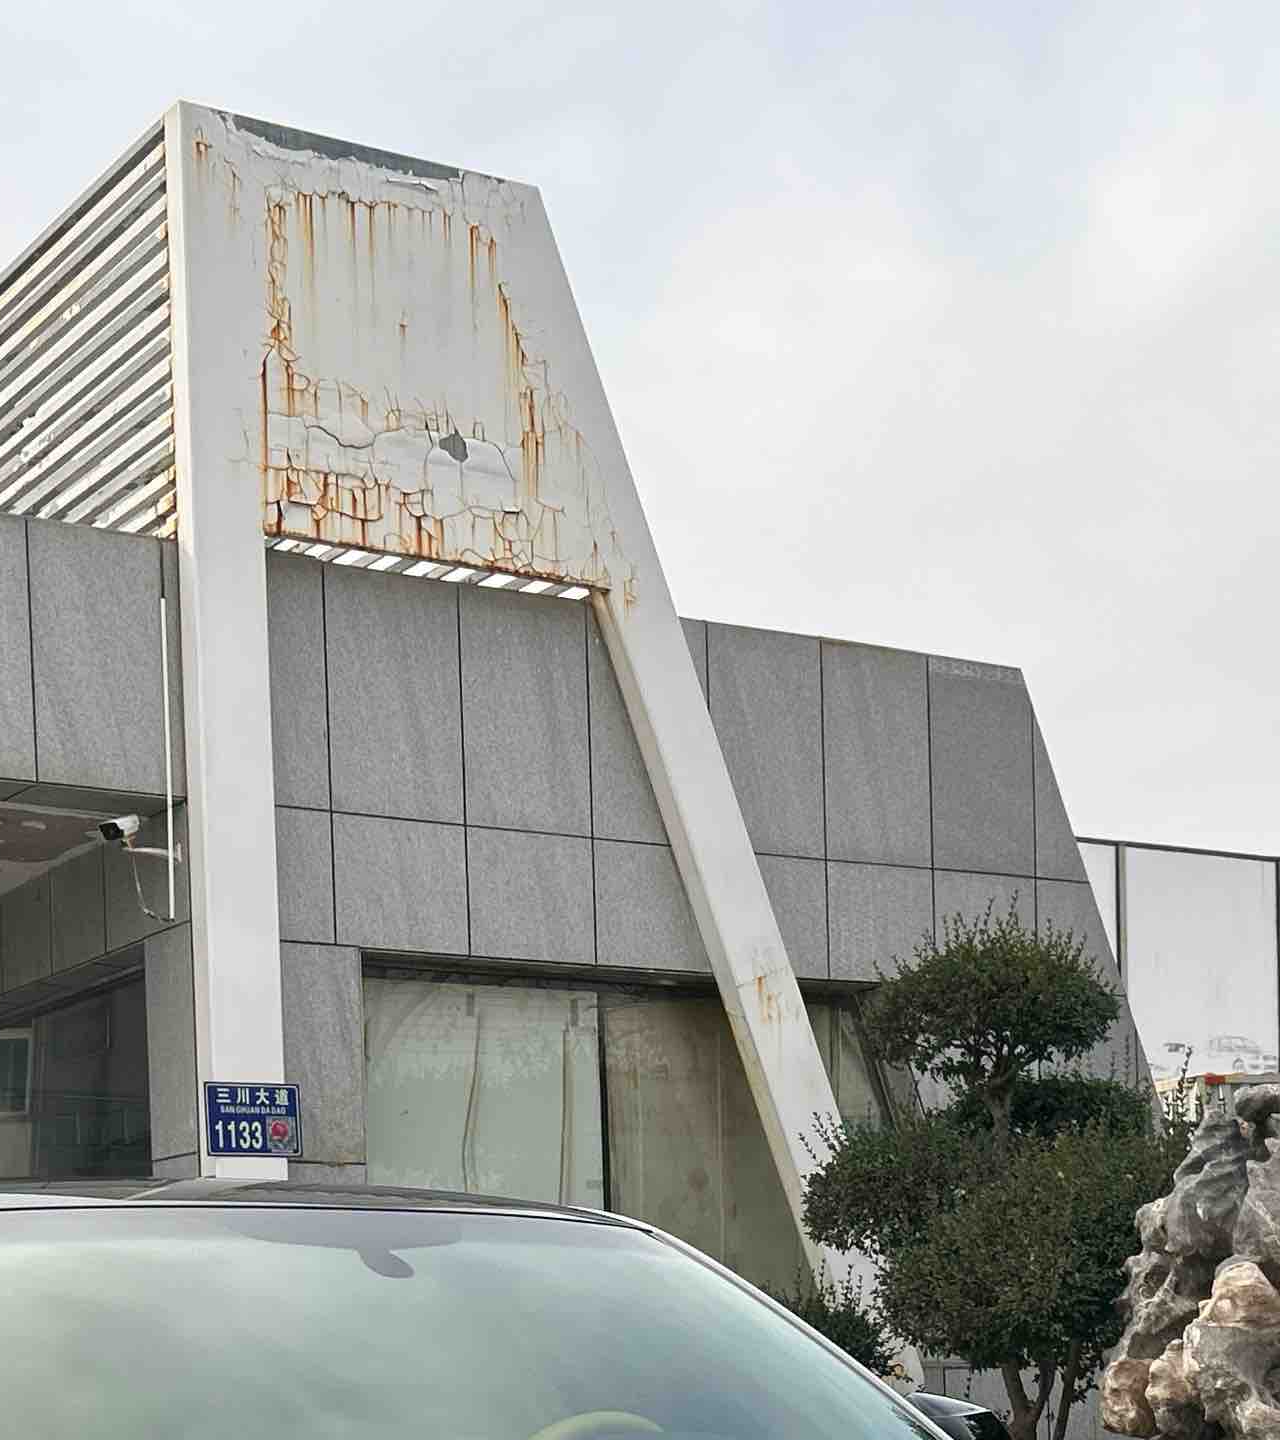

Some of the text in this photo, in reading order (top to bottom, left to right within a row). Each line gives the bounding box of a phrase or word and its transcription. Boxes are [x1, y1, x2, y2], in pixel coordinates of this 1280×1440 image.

[216, 1087, 289, 1105] 三川大道
[215, 1120, 263, 1149] 1133
